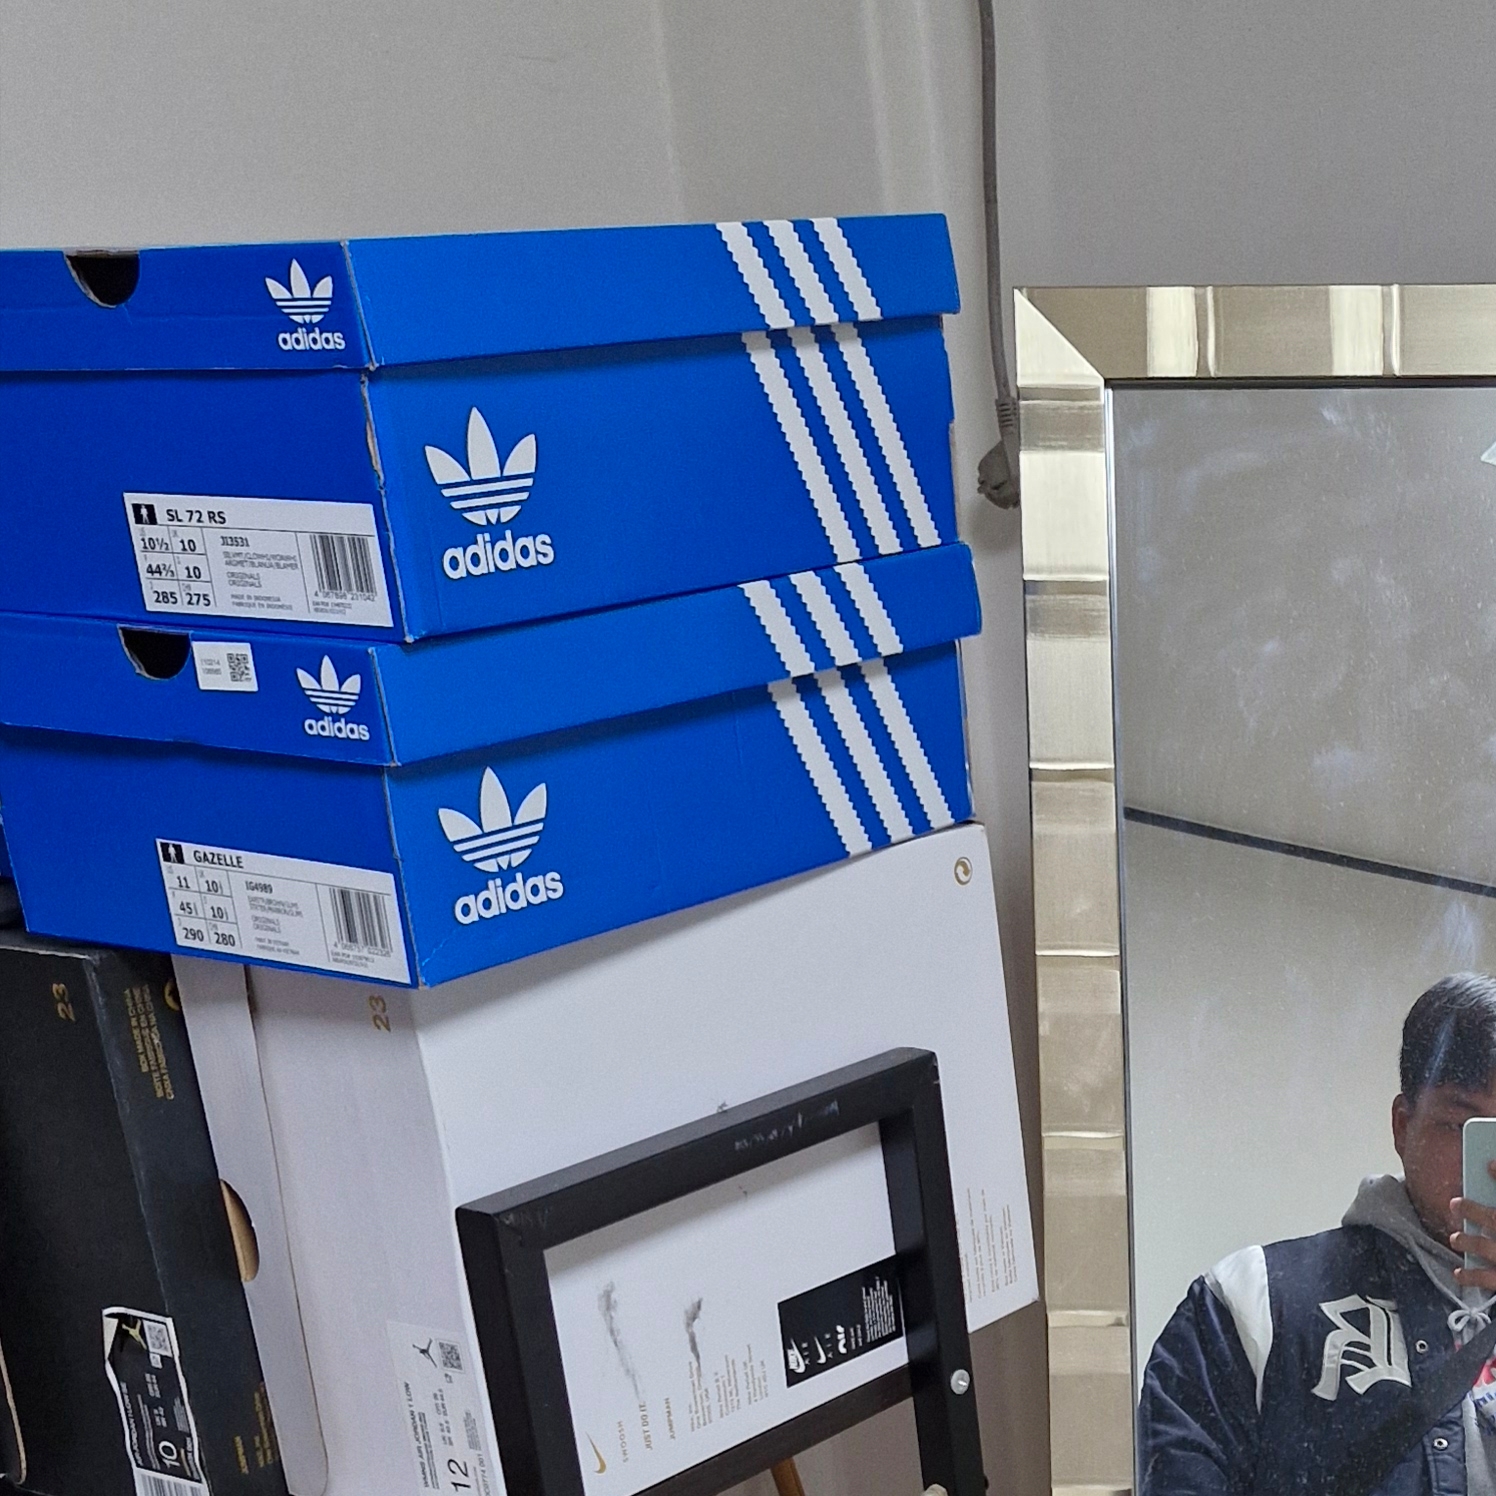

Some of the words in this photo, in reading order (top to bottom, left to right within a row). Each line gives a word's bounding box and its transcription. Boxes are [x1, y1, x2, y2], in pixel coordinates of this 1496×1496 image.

[277, 327, 346, 352] adidas
[166, 508, 183, 523] SL
[186, 509, 204, 524] 72
[207, 510, 227, 525] RS
[180, 539, 197, 552] 10
[443, 529, 555, 581] adidas
[185, 566, 202, 579] 10
[152, 590, 178, 605] 285
[185, 592, 211, 607] 275
[304, 716, 370, 742] adidas
[193, 850, 244, 869] GAZELLE
[176, 875, 191, 889] 11
[454, 868, 564, 925] adidas
[182, 927, 205, 942] 290
[214, 931, 236, 947] 280
[51, 982, 76, 1022] 23
[368, 994, 392, 1033] 23
[640, 1414, 650, 1428] DO
[617, 1420, 629, 1463] SWOOSH
[642, 1429, 653, 1451] JUST
[159, 1440, 181, 1468] 10
[447, 1458, 471, 1492] 12
